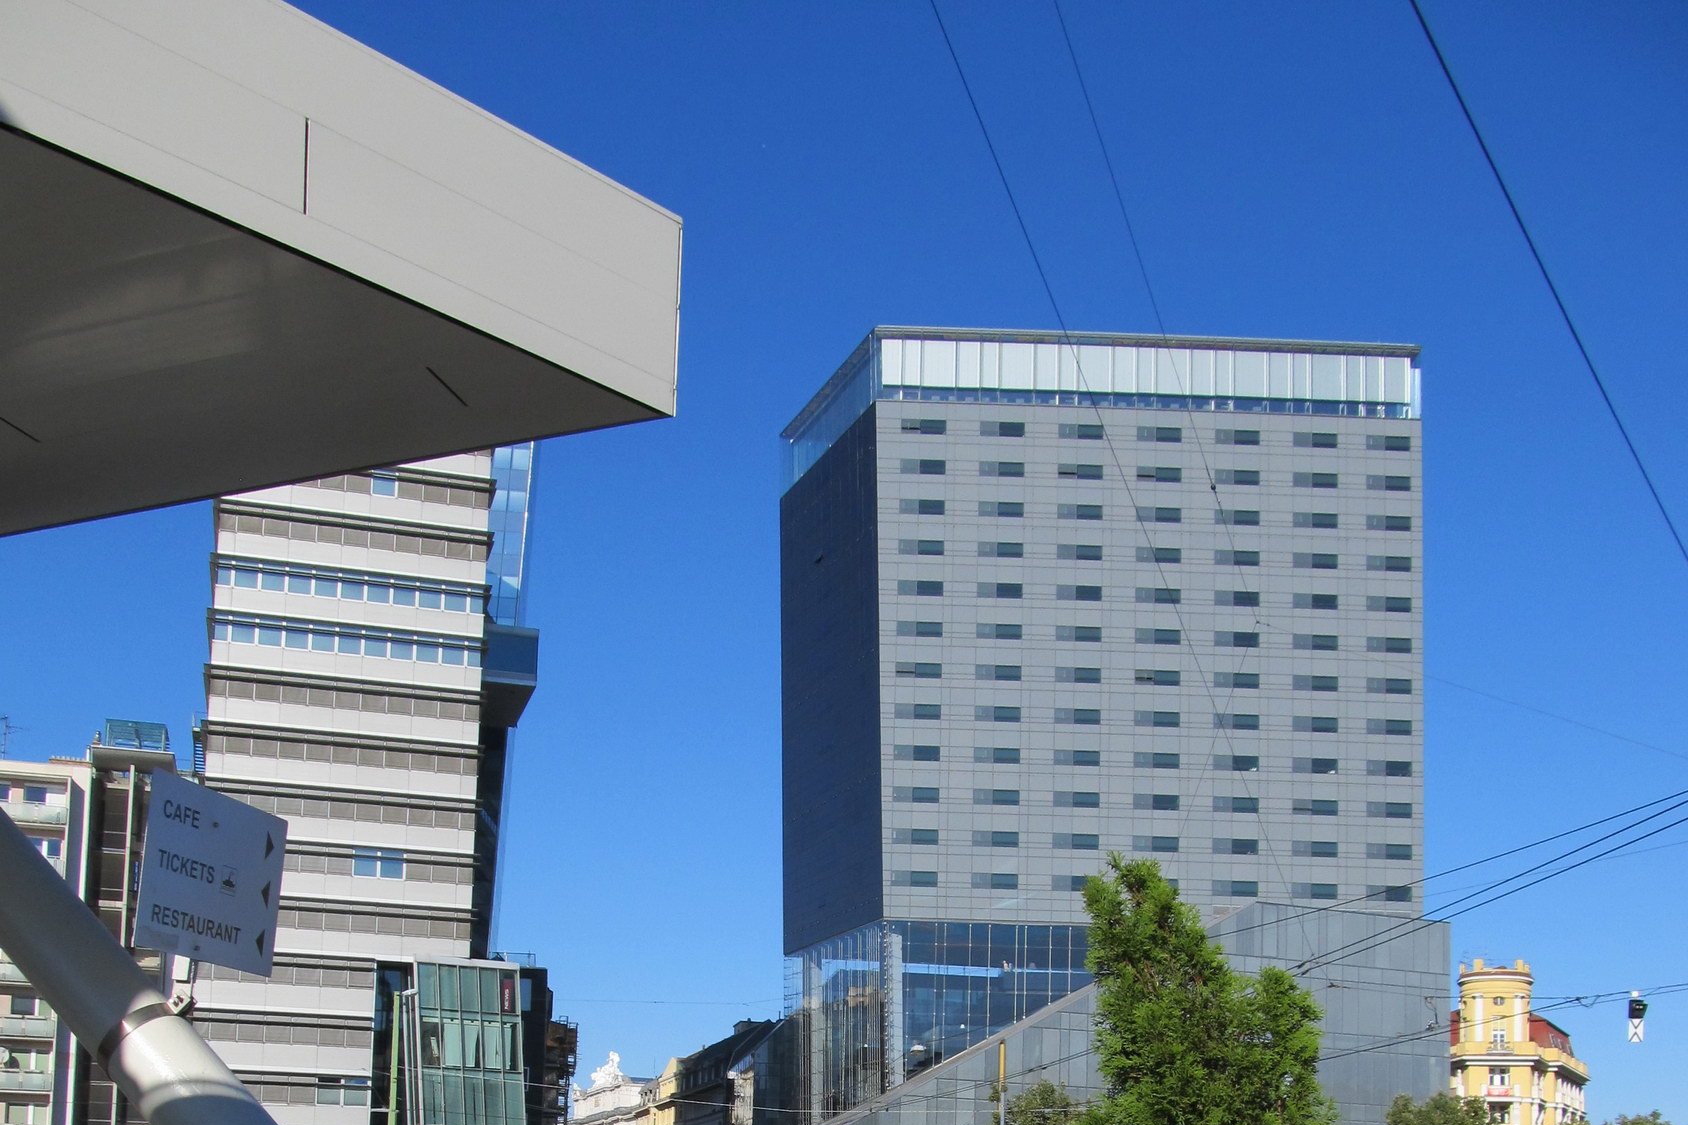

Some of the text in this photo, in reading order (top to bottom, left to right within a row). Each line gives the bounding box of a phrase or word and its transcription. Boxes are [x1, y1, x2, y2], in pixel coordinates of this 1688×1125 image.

[163, 799, 201, 829] CAFE
[158, 849, 215, 884] TICKETS
[151, 903, 241, 944] RESTAURANT
